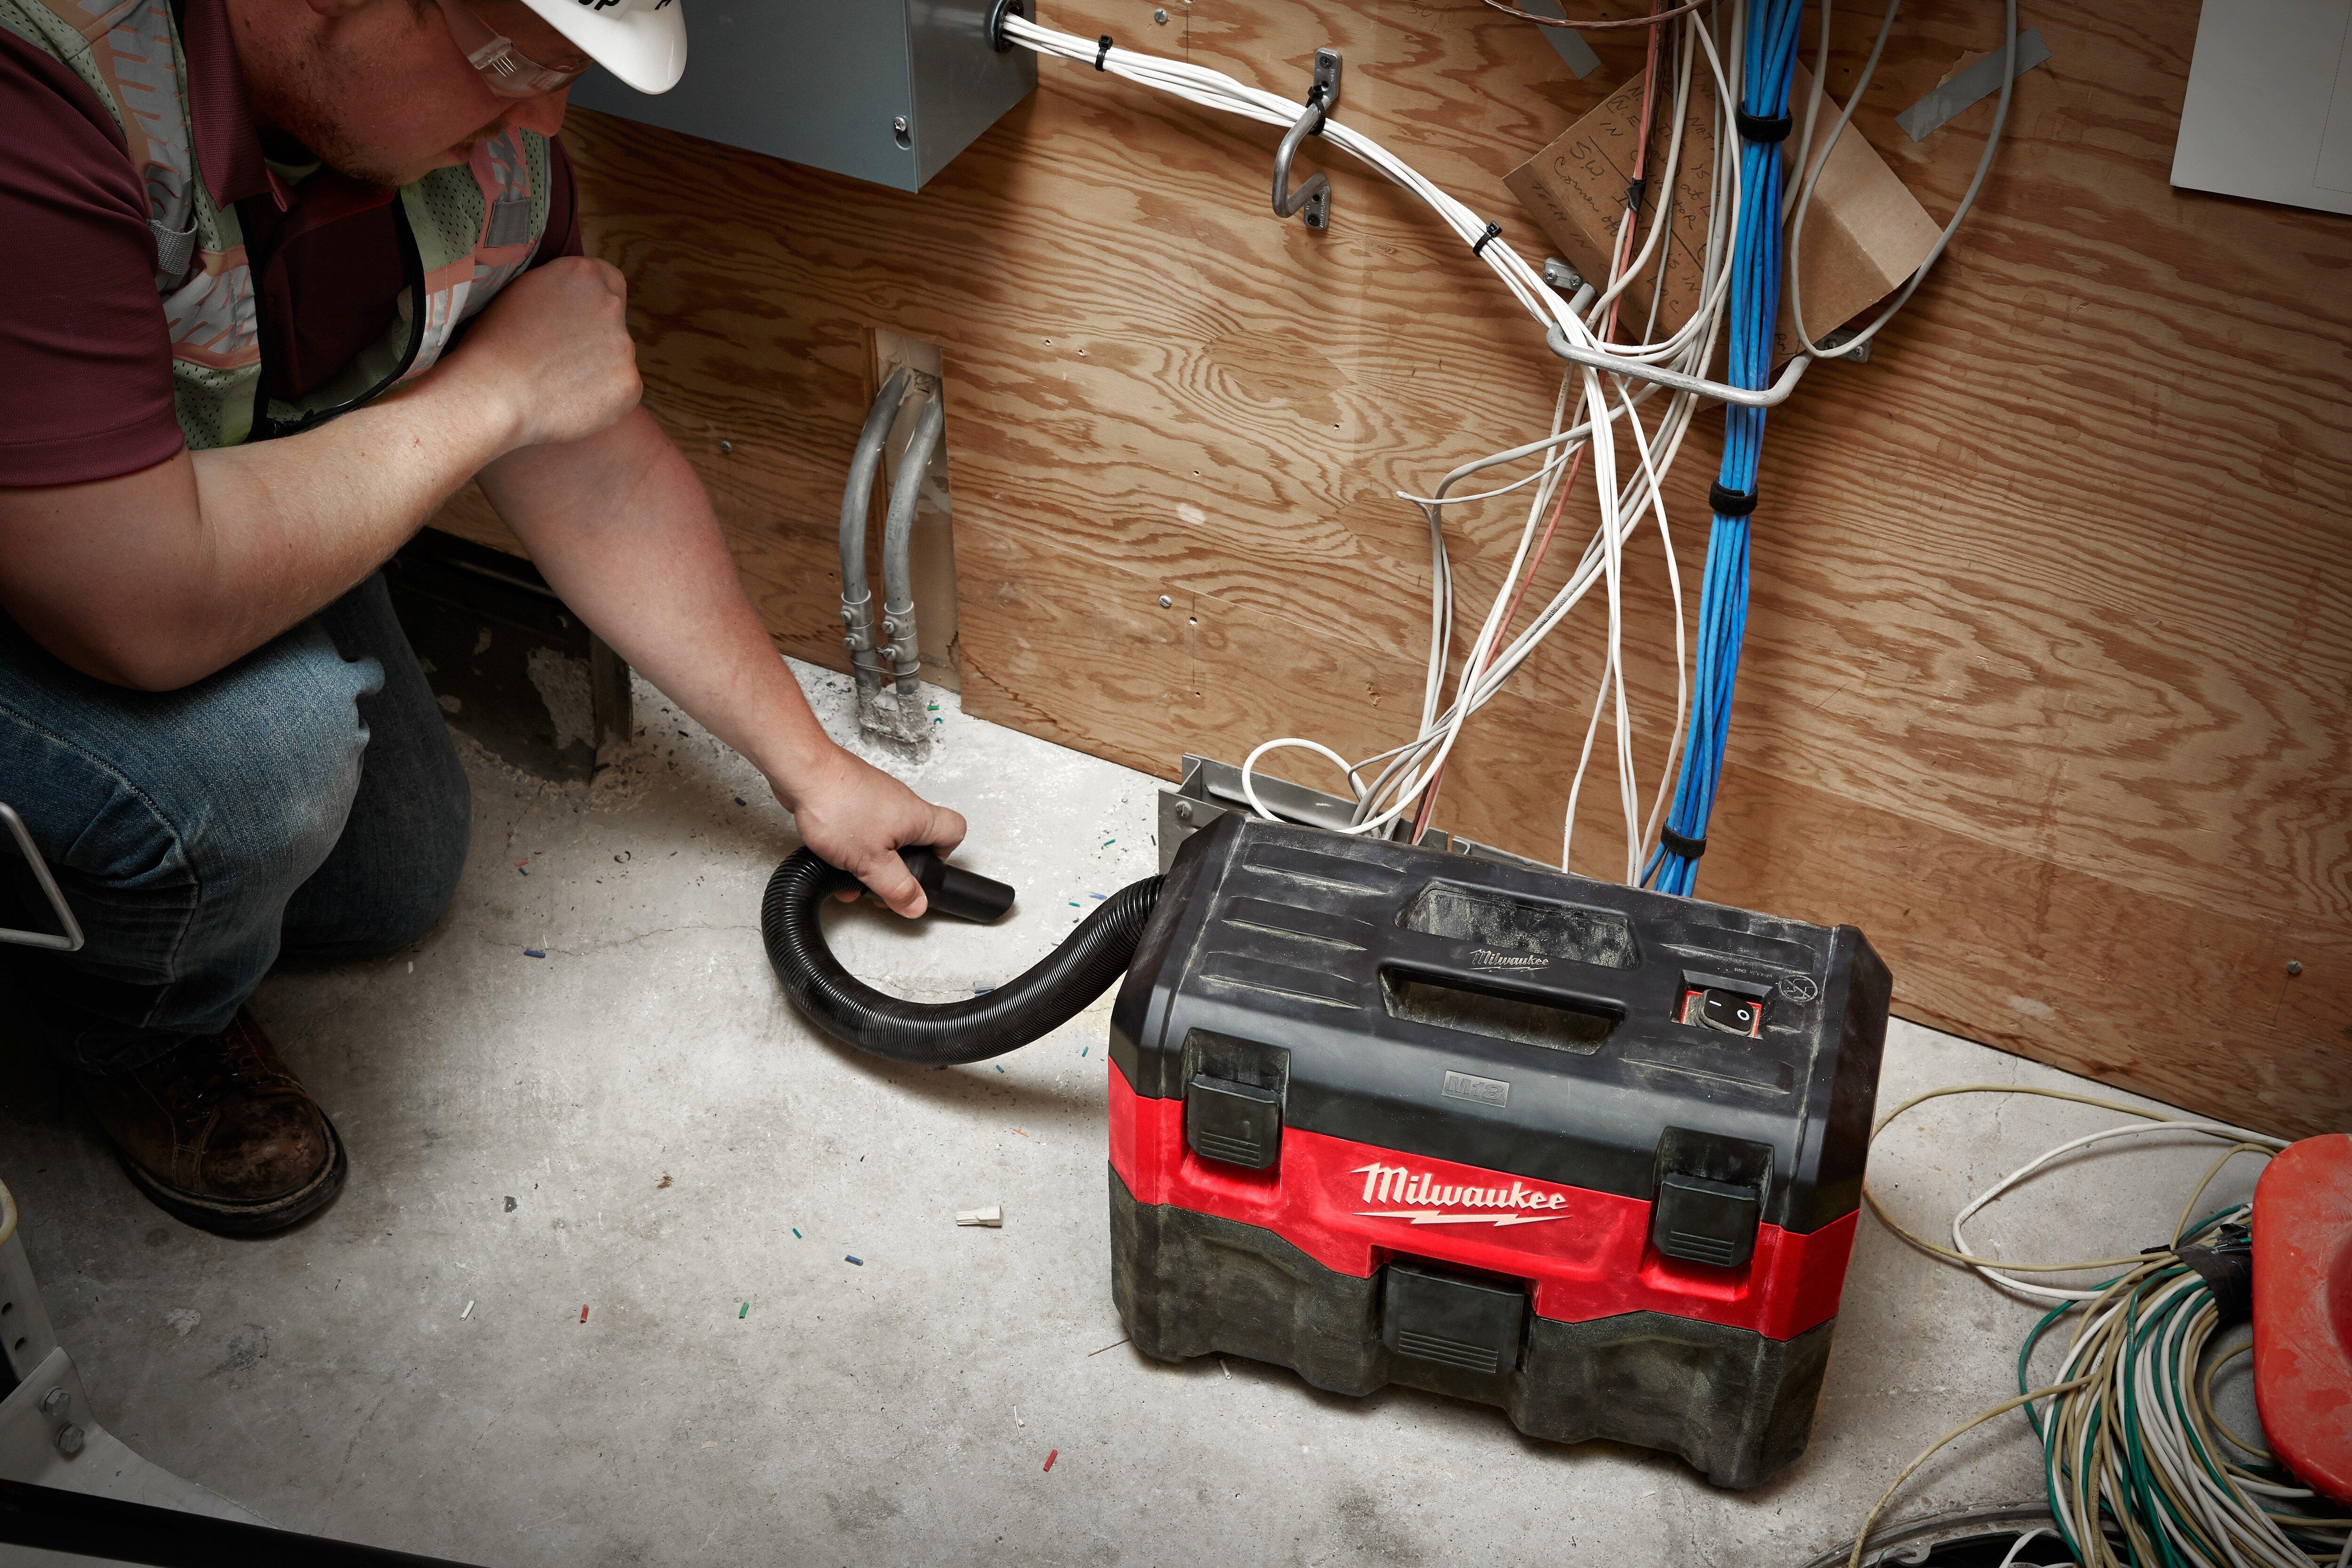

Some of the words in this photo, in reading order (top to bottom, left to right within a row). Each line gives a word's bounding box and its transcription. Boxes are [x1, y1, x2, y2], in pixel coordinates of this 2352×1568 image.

[1470, 948, 1549, 966] Milwaukee
[1448, 1075, 1504, 1101] M18
[1351, 1162, 1569, 1210] Milwaukee
